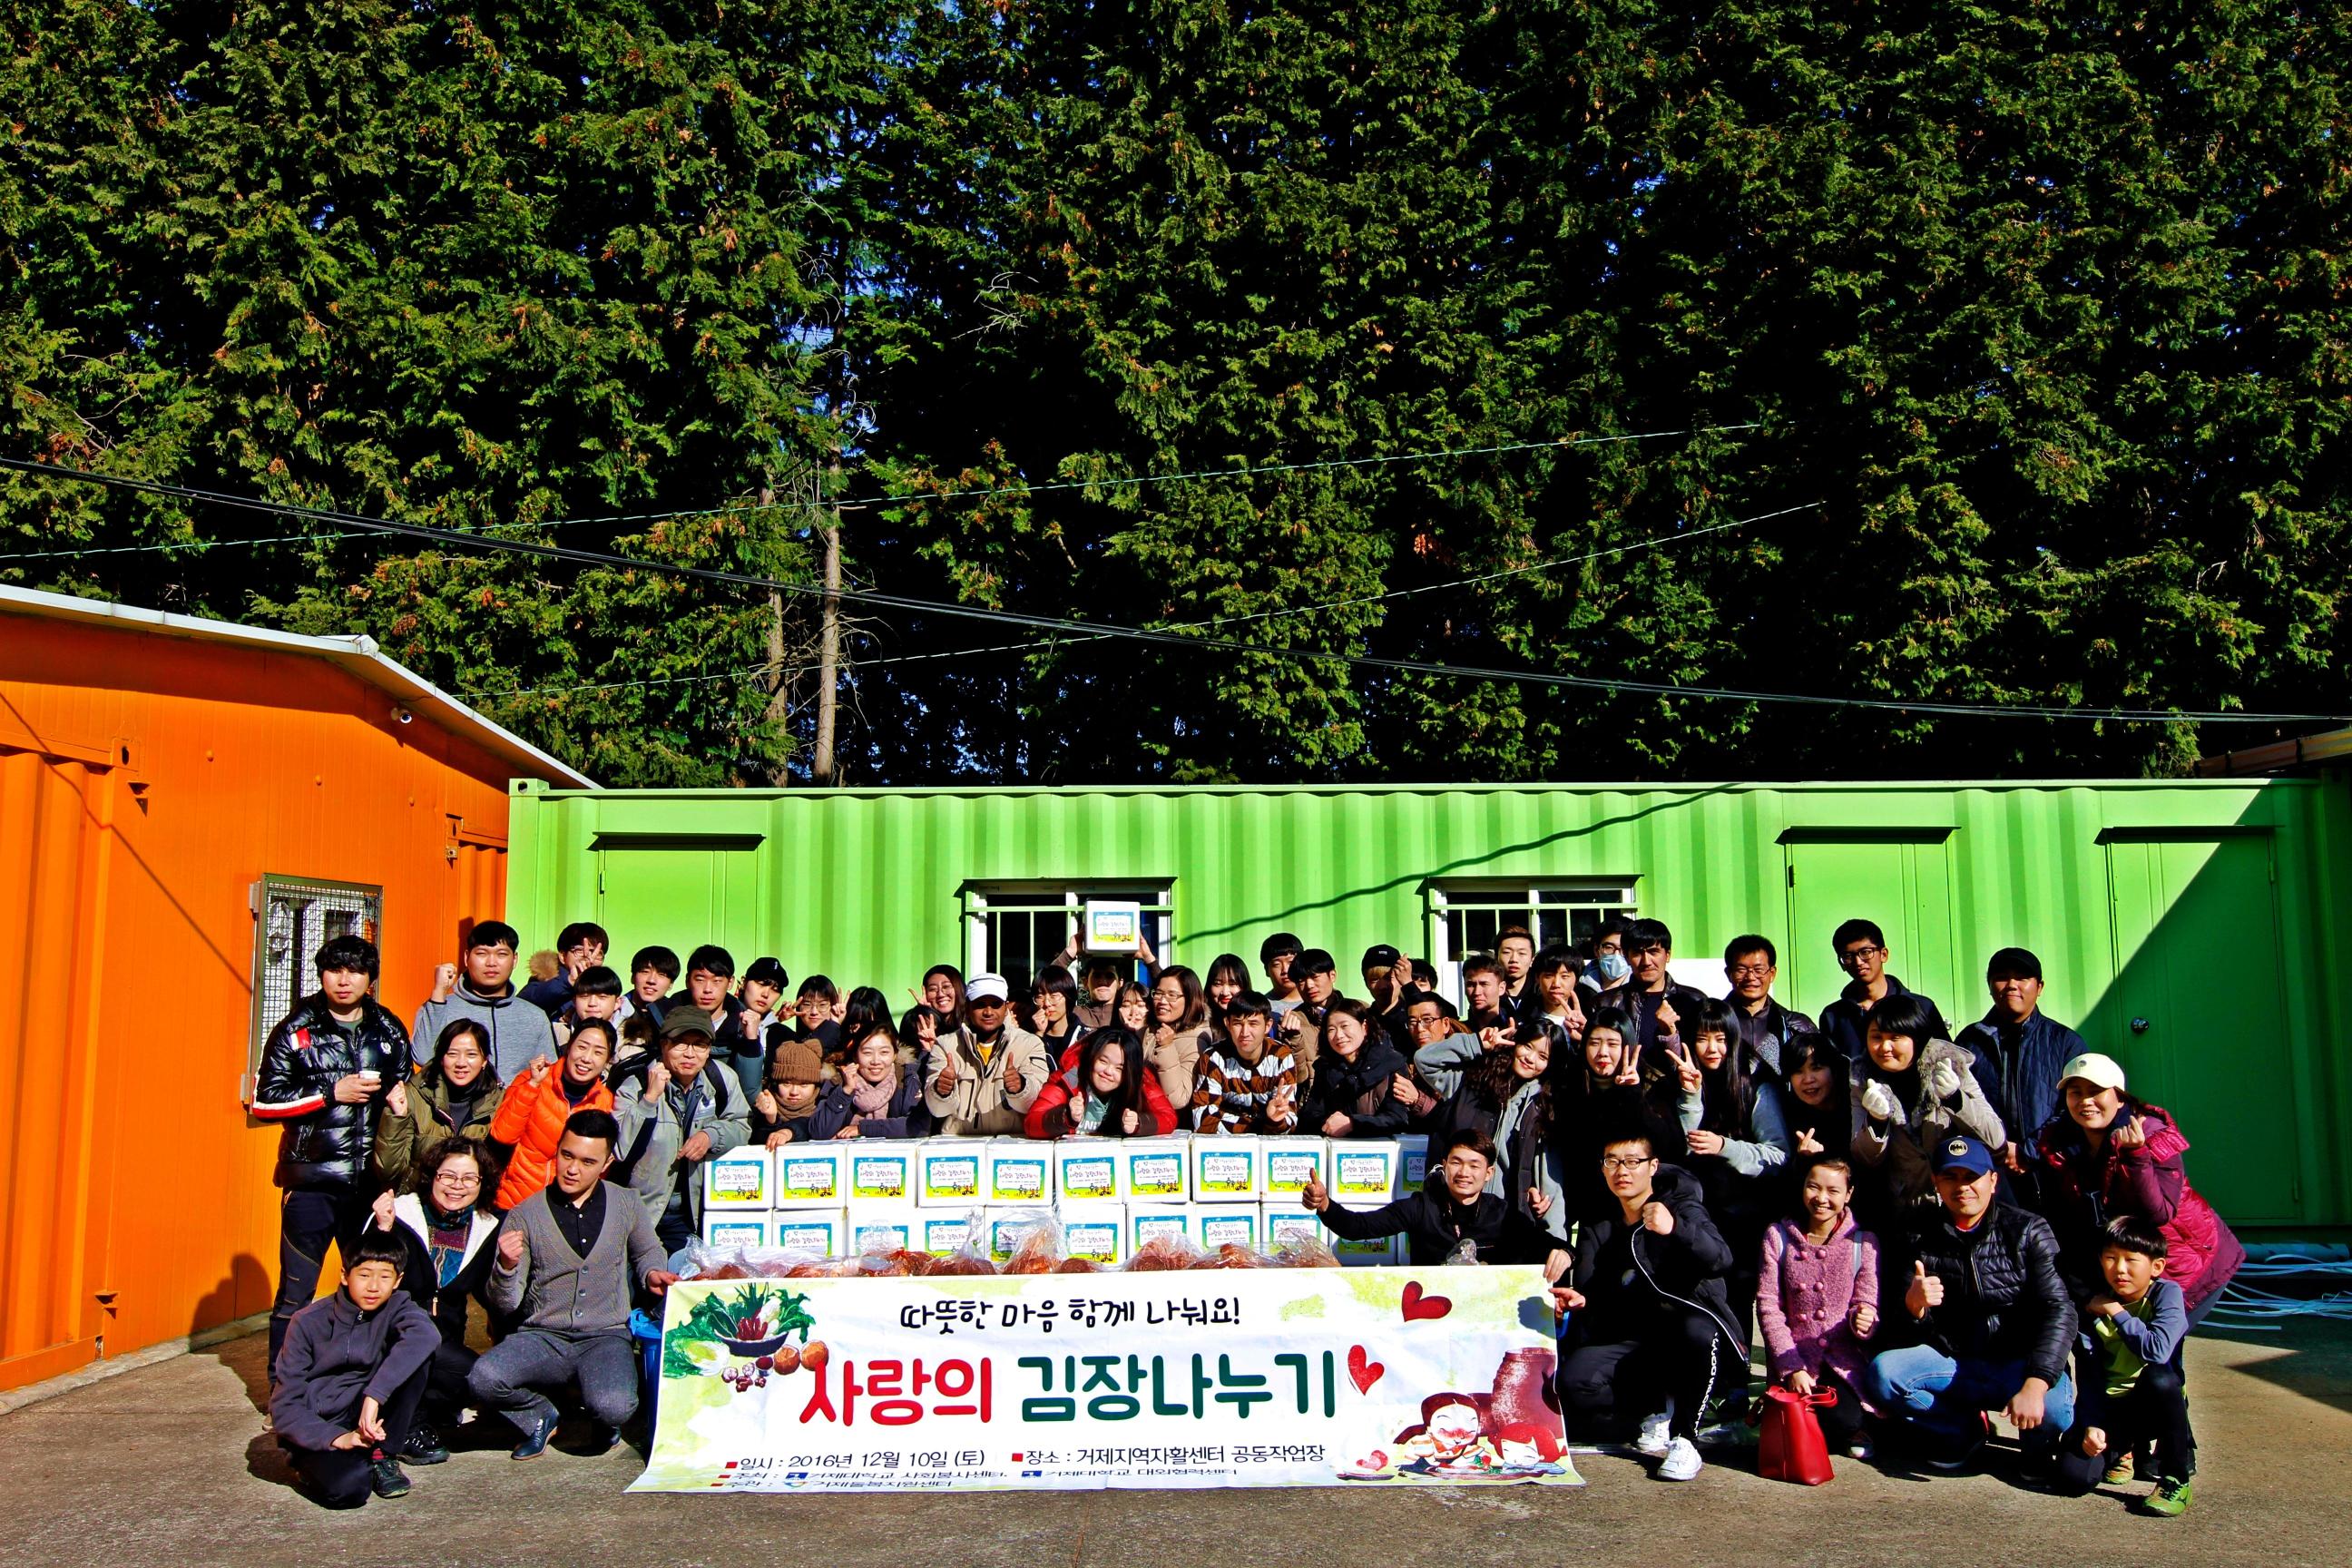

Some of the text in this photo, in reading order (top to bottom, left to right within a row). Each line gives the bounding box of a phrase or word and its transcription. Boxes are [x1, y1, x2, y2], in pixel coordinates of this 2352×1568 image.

[900, 1297, 1240, 1335] 따뜻한 마음 함께 나눠요!
[799, 1350, 1335, 1426] 사랑의 김장나누기
[740, 1457, 773, 1470] 일시
[788, 1453, 853, 1469] 2016년
[861, 1451, 900, 1469] 12월
[909, 1451, 947, 1468] 10일
[954, 1449, 985, 1466] (토)
[1026, 1450, 1061, 1465] 장소
[1076, 1446, 1225, 1465] 거제지역자활센터
[1230, 1444, 1326, 1464] 공동작업장
